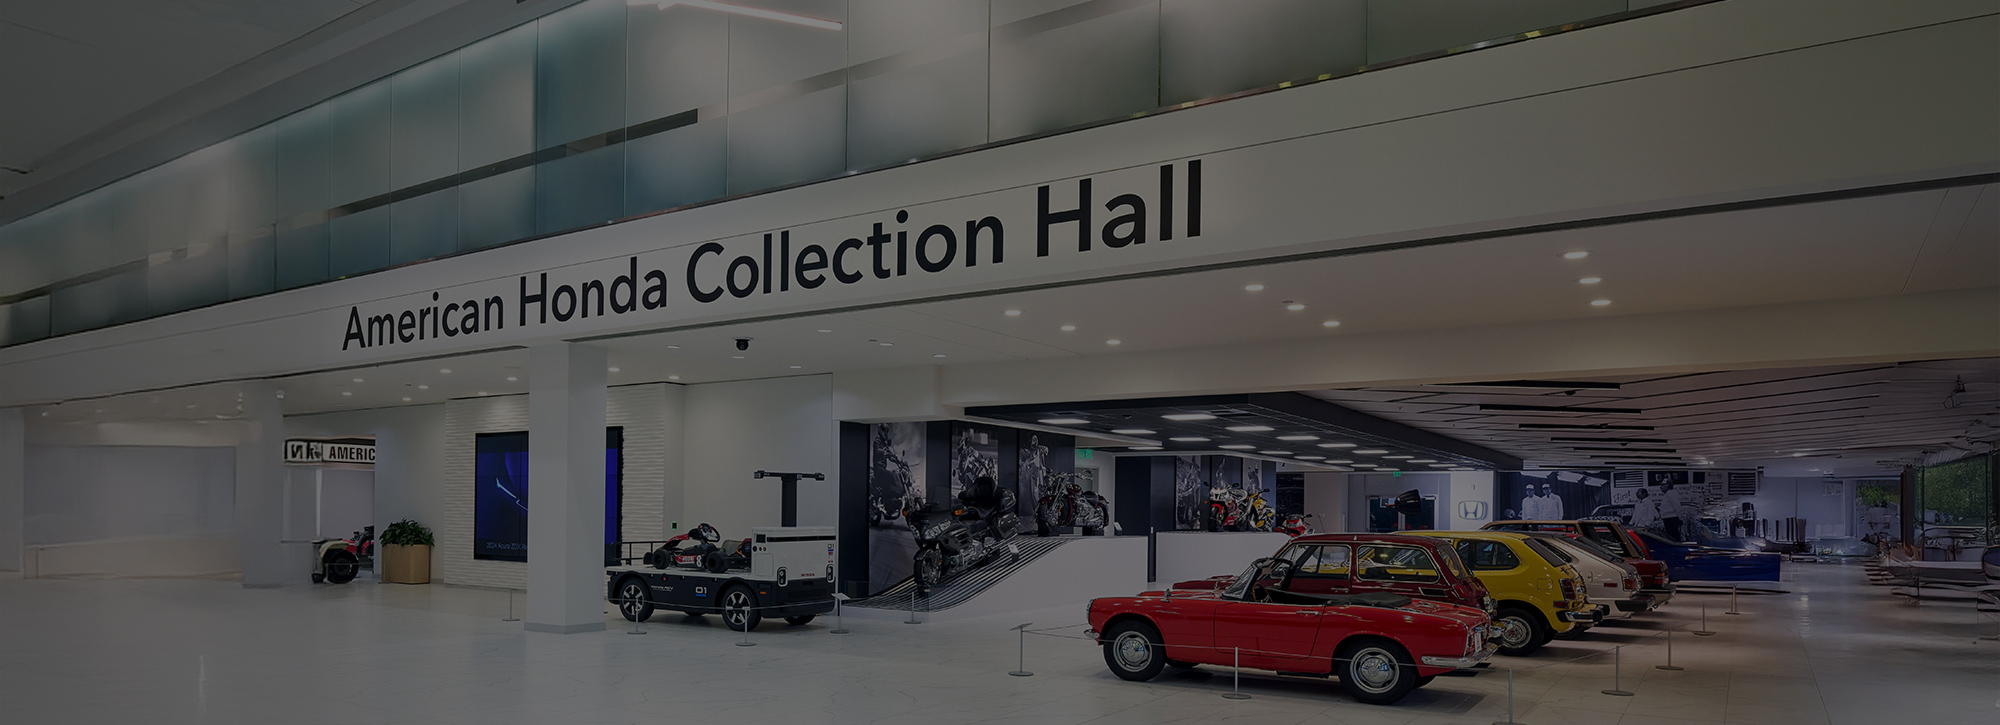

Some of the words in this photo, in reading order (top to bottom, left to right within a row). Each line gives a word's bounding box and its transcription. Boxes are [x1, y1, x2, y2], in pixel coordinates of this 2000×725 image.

[342, 295, 504, 351] American
[520, 256, 668, 327] Honda
[687, 209, 1004, 304] Collection
[1037, 159, 1202, 258] Hall
[329, 446, 375, 461] AMERIC
[696, 555, 702, 567] 8
[695, 586, 707, 594] 01
